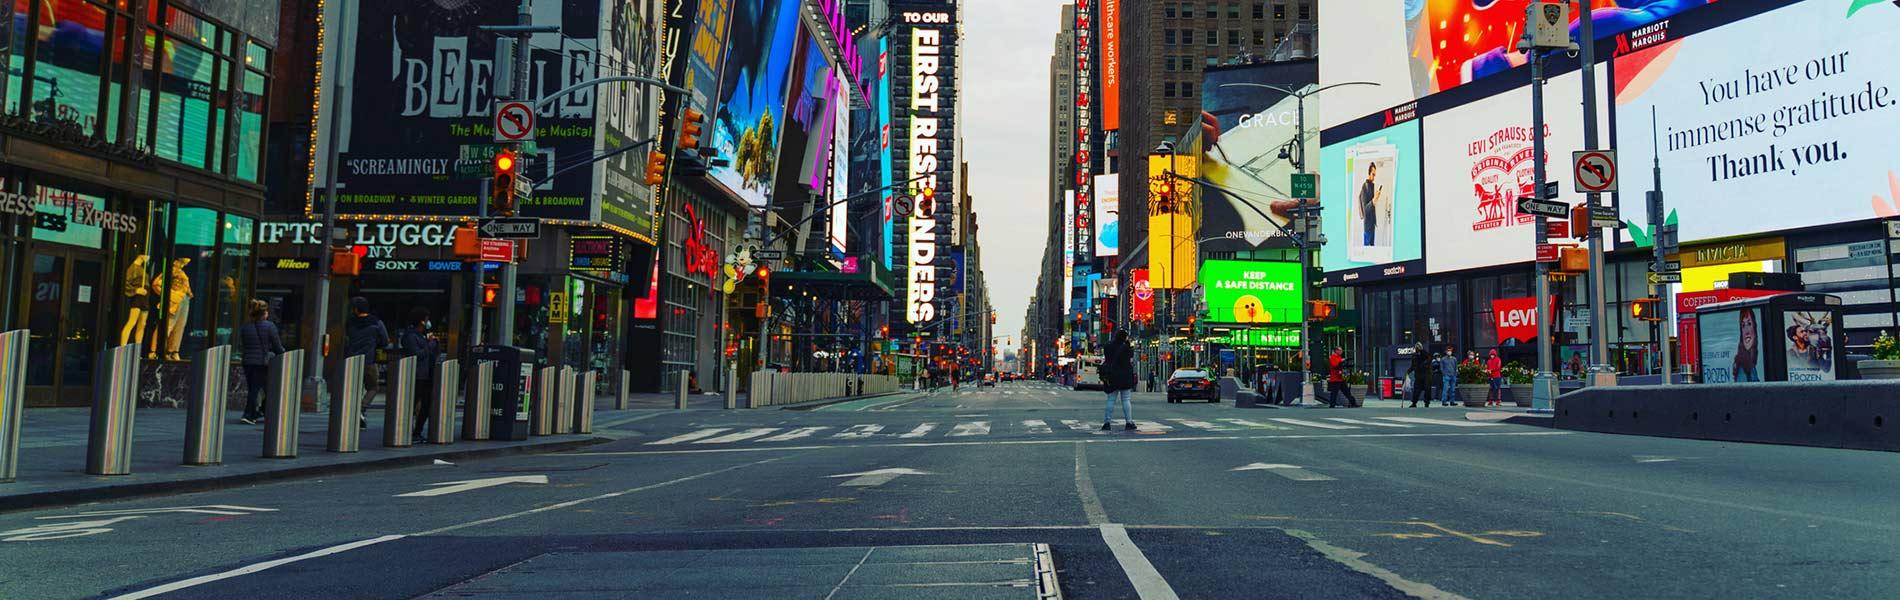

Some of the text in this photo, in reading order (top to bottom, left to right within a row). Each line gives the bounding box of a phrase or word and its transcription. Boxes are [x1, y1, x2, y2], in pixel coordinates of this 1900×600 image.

[904, 12, 949, 23] TO OUR
[1632, 20, 1669, 39] MARRIOTT
[1632, 32, 1665, 49] MARQUIS
[915, 28, 940, 112] FIRST
[1107, 41, 1117, 88] workers.
[401, 48, 591, 117] BEELE
[1699, 51, 1849, 105] You have our
[1394, 102, 1418, 114] MARRIOTT
[1394, 110, 1415, 122] MARQUIS
[1668, 80, 1896, 151] immense gratitude.
[451, 124, 470, 136] The
[1468, 139, 1486, 156] LEVI
[1489, 126, 1527, 150] STRAUSS
[483, 146, 495, 159] 46
[1707, 140, 1847, 182] Thank you.
[342, 195, 352, 204] ON
[354, 195, 396, 204] BROADWAY
[447, 196, 477, 205] GARDEN
[543, 197, 584, 206] BROADWAY
[1526, 202, 1562, 213] ONE WAY
[75, 202, 137, 234] EXPRESS
[259, 222, 323, 245] IFTS
[486, 224, 532, 233] ONE WAY
[368, 246, 396, 258] NY
[1697, 244, 1747, 261] INVICTA
[276, 259, 310, 269] Nikon
[375, 261, 420, 270] SONY
[428, 261, 461, 271] BOWER
[1243, 271, 1266, 280] KEEP
[1215, 280, 1295, 291] A SAFE DISTANCE
[551, 294, 561, 318] ATM
[1790, 372, 1821, 383] FROZEN
